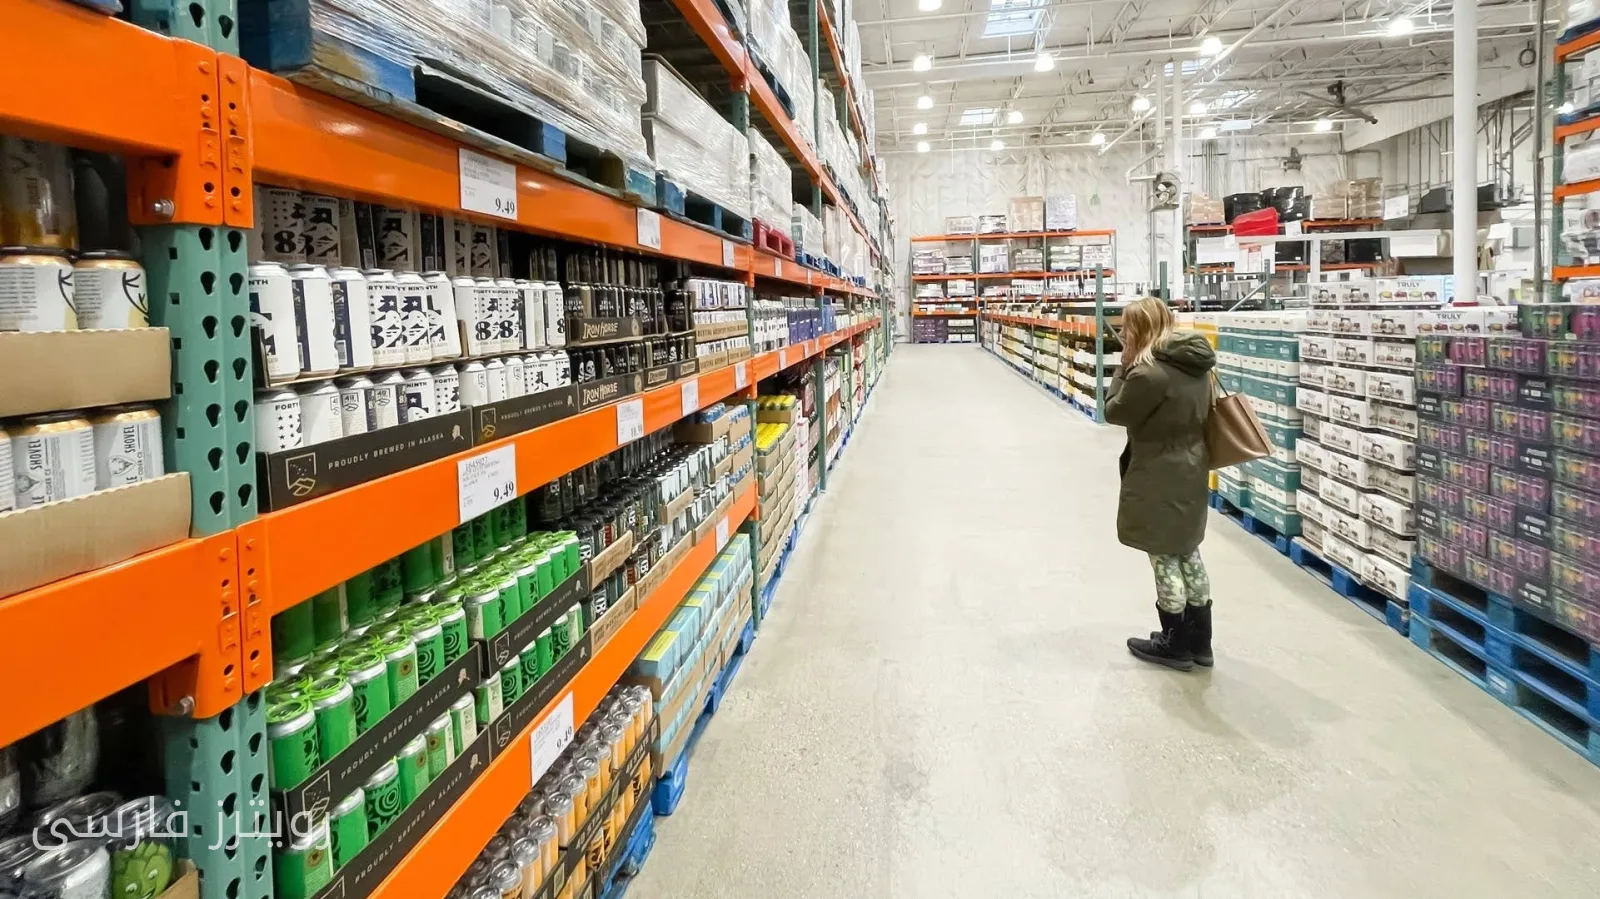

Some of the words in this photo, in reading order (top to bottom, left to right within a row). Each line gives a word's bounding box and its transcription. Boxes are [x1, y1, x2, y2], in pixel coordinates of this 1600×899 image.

[495, 198, 515, 215] 9.49
[582, 322, 600, 340] IRON
[600, 318, 618, 336] HORSE
[582, 387, 600, 406] IRON
[600, 382, 618, 400] HORSE
[501, 411, 523, 420] PROUDLY
[123, 425, 136, 454] SHOVEL
[328, 452, 370, 470] PROUDLY
[373, 442, 405, 458] BREWED
[408, 440, 416, 448] IN
[419, 433, 445, 445] ALASKA
[28, 439, 43, 470] SHOVEL
[493, 480, 514, 503] 9.49
[340, 742, 380, 780] PROUDLY
[382, 714, 414, 744] BREWED
[416, 703, 424, 714] IN
[426, 684, 450, 706] ALASKA
[354, 843, 394, 884] PROUDLY
[397, 812, 427, 844] BREWED
[428, 800, 436, 812] IN
[438, 772, 463, 799] ALASKA
